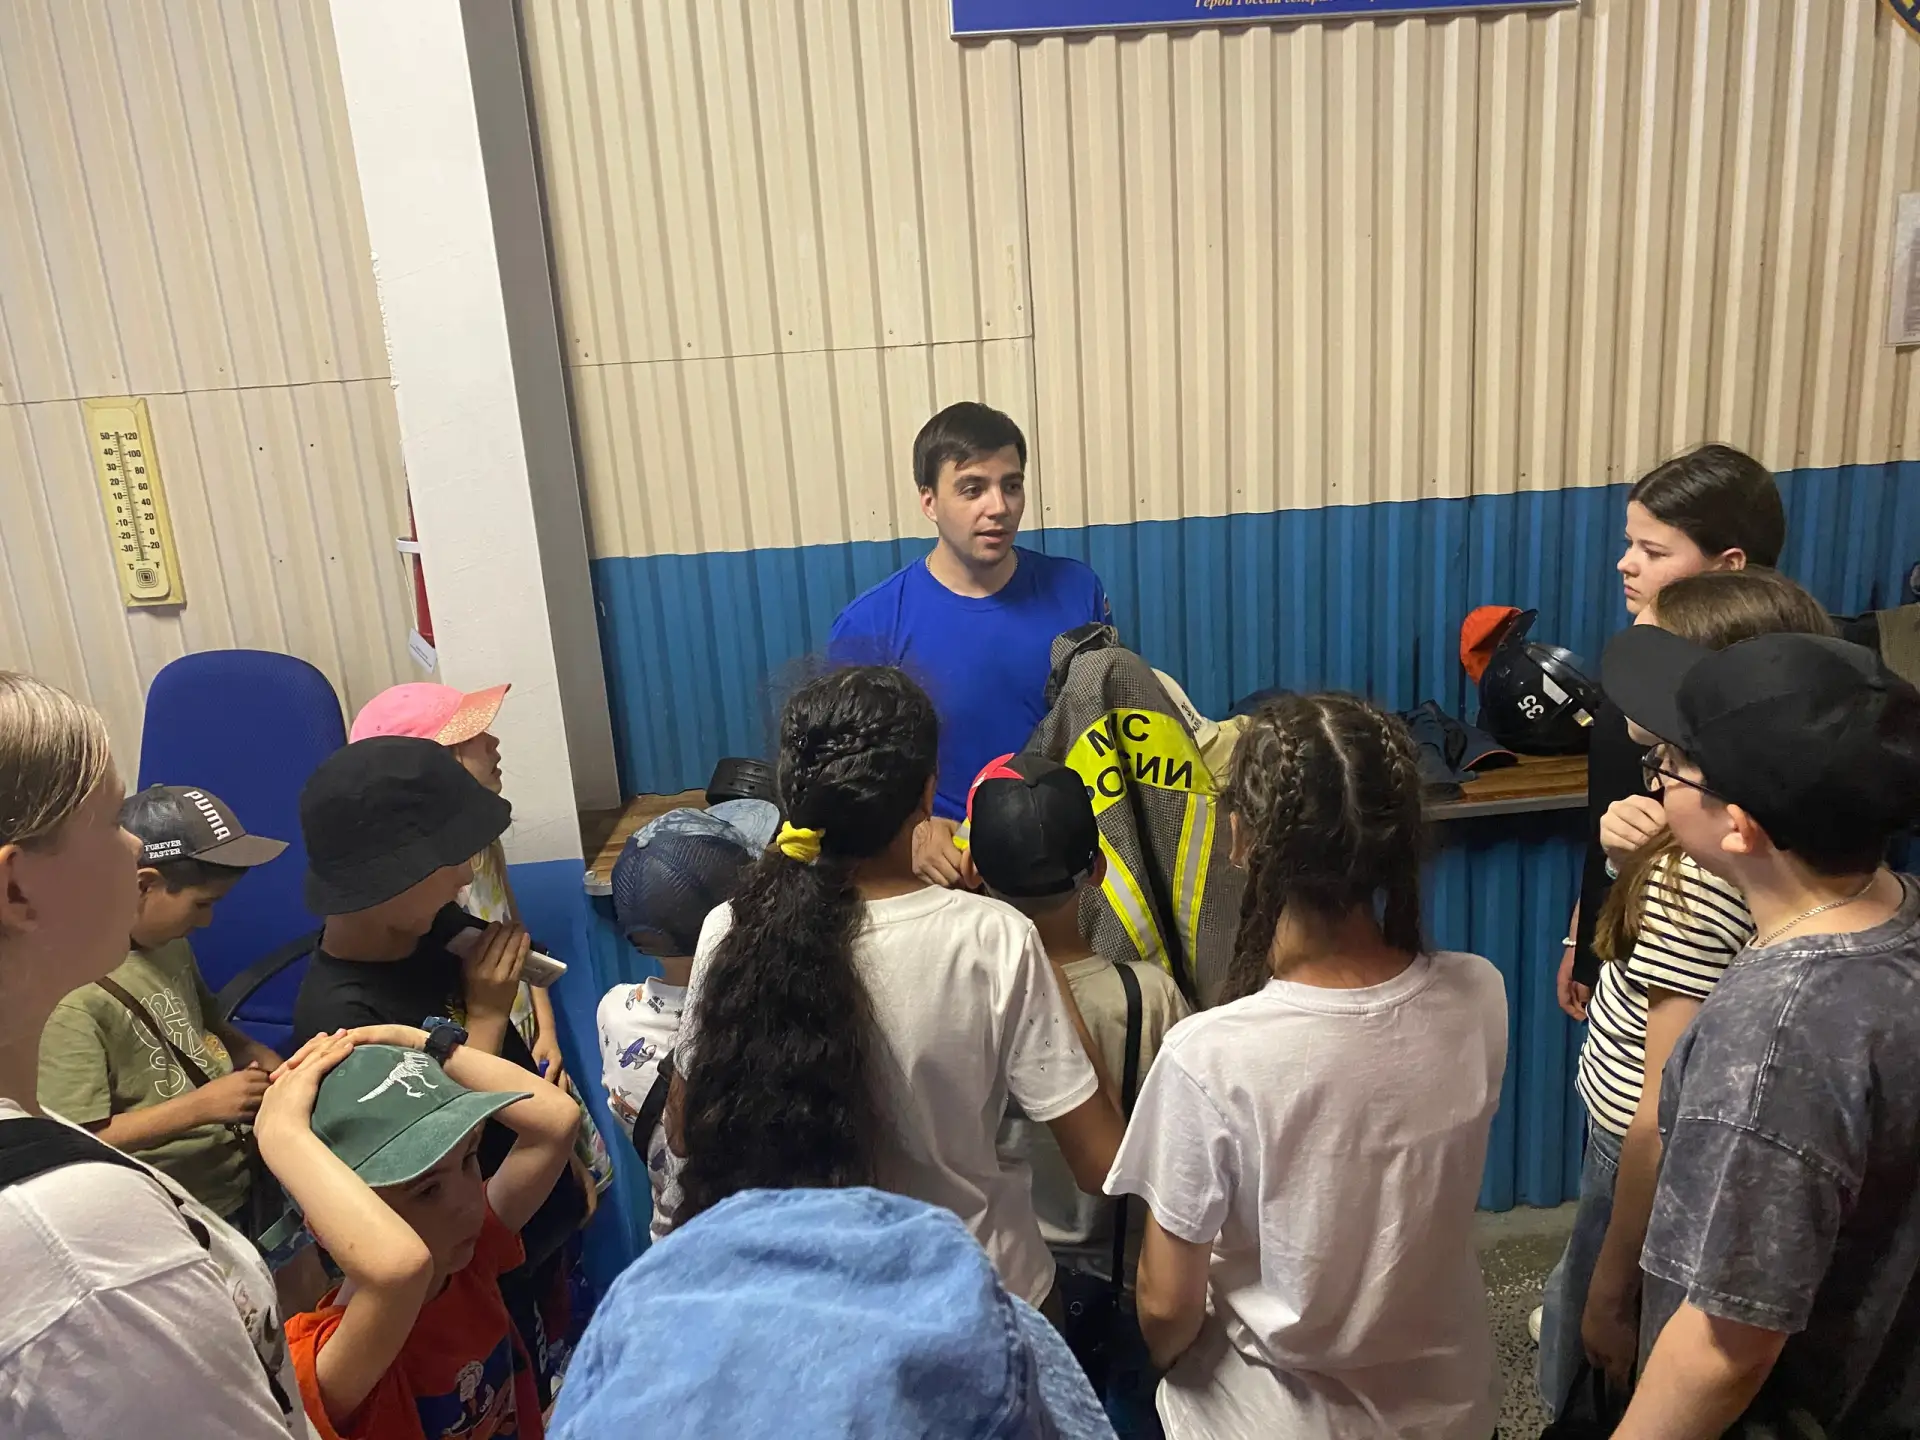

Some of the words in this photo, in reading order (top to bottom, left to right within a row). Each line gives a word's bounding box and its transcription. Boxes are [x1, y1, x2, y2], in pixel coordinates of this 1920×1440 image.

[100, 432, 110, 440] 50
[124, 432, 137, 440] 120
[106, 463, 116, 471] 30
[113, 492, 122, 500] 10
[141, 498, 151, 506] 40
[1517, 694, 1545, 720] 35
[183, 790, 231, 841] PUMA
[145, 840, 182, 852] FOREVER
[149, 848, 182, 860] FASTER
